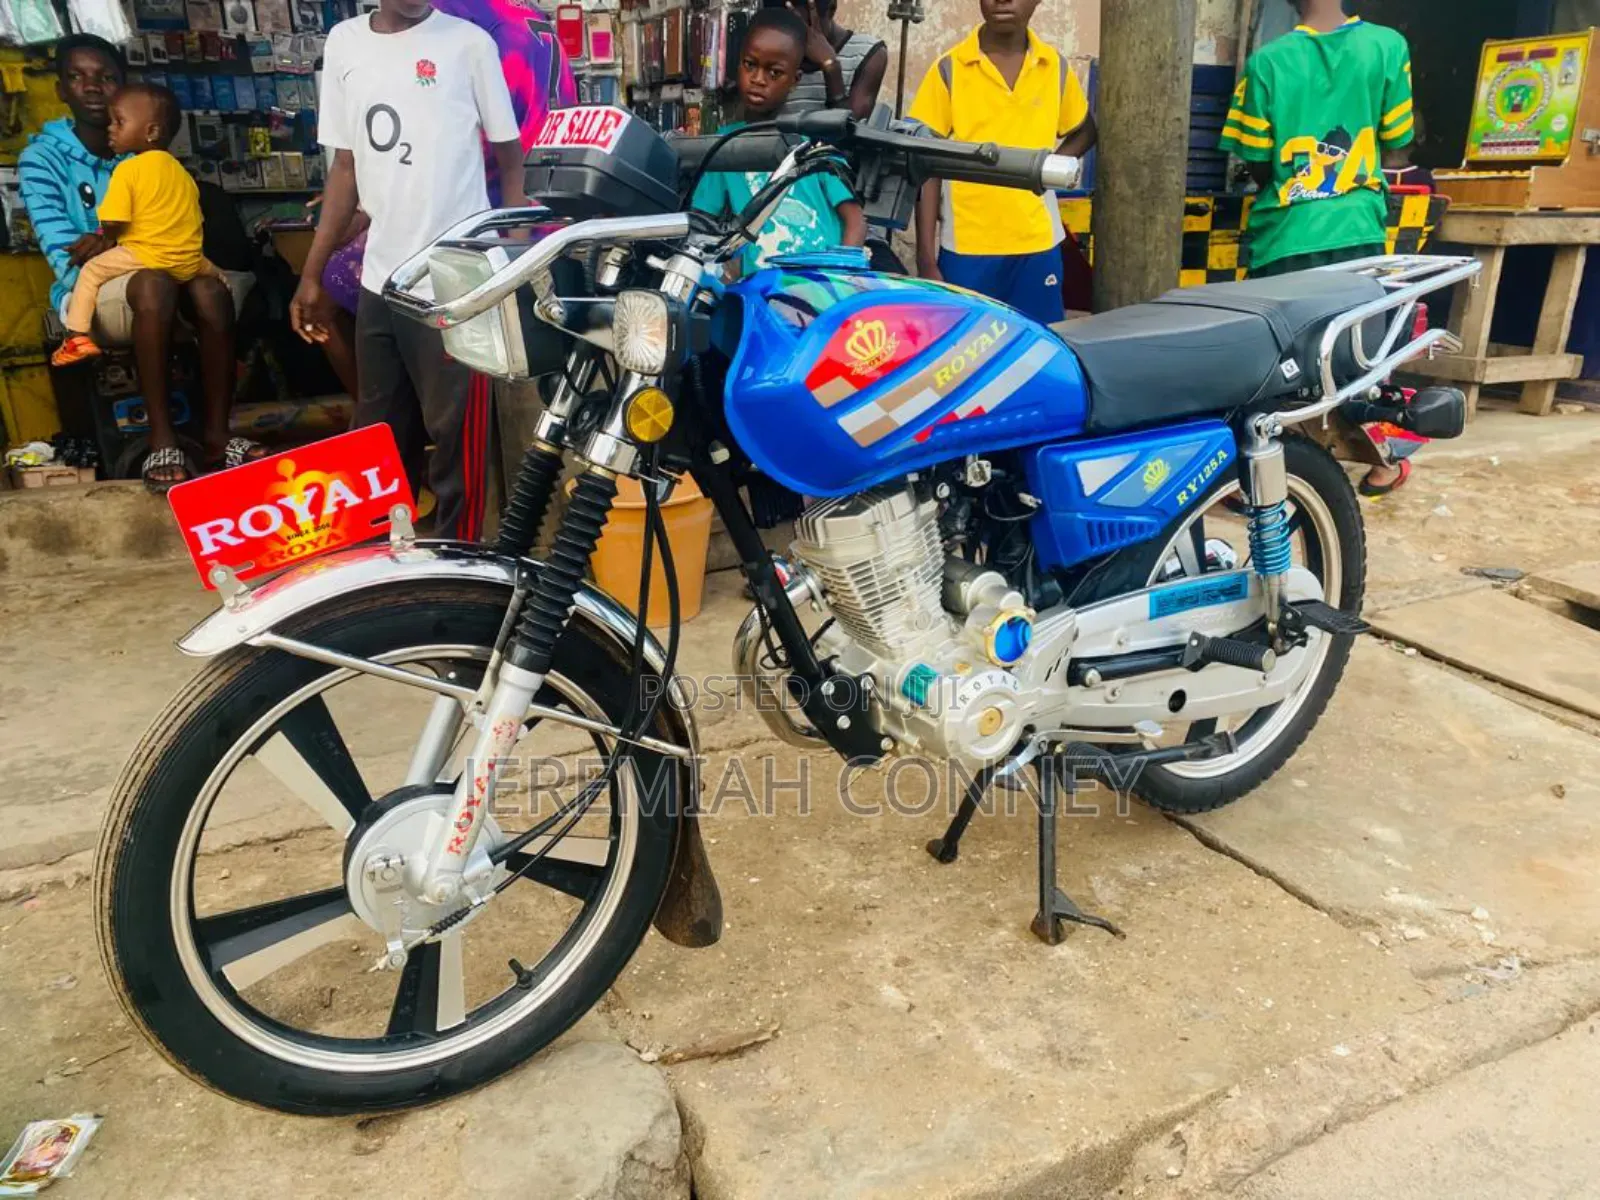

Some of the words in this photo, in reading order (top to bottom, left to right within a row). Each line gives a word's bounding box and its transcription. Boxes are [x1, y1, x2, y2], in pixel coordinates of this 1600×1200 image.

[560, 110, 624, 149] SALE
[933, 319, 1008, 389] ROYAL
[190, 466, 400, 556] ROYAL
[959, 674, 1019, 704] ROYAL
